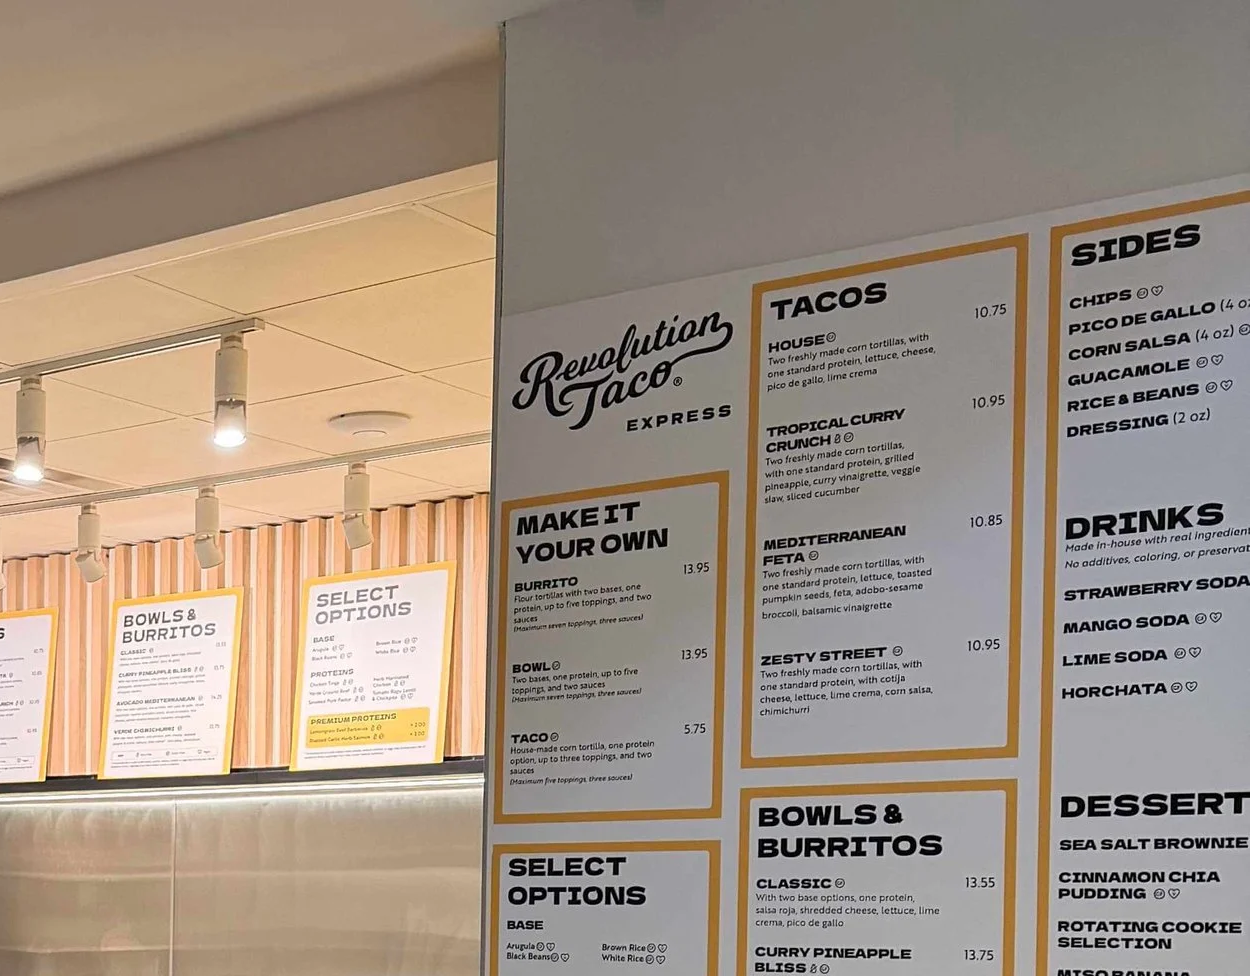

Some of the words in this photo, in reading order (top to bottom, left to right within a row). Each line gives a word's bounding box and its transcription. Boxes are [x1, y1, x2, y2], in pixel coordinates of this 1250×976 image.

[1071, 224, 1200, 266] SIDES
[770, 282, 887, 320] TACOS
[1069, 289, 1132, 309] CHIPS
[975, 303, 1007, 319] 10.75
[1069, 317, 1118, 335] PICO
[1121, 312, 1147, 327] DE
[1150, 302, 1215, 322] GALLO
[768, 334, 825, 353] HOUSE
[1068, 343, 1121, 360] CORN
[1125, 332, 1191, 352] SALSA
[1213, 324, 1234, 339] oz)
[512, 312, 733, 420] Revolution
[1068, 358, 1190, 386] GUACAMOLE
[972, 394, 1005, 409] 10.95
[1067, 395, 1115, 412] RICE
[1118, 394, 1129, 405] &
[1133, 384, 1199, 403] BEANS
[627, 405, 731, 432] EXPRESS
[766, 417, 849, 437] TROPICAL
[850, 408, 905, 426] CURRY
[1067, 414, 1169, 438] DRESSING
[1173, 412, 1185, 425] (2
[1190, 408, 1210, 422] oz)
[766, 434, 831, 453] CRUNCH
[517, 507, 599, 536] MAKE
[604, 501, 640, 524] IT
[970, 514, 1003, 528] 10.85
[1065, 503, 1224, 543] DRINKS
[516, 538, 595, 564] YOUR
[601, 528, 668, 554] OWN
[763, 525, 906, 551] MEDITERRANEAN
[1065, 542, 1094, 552] Made
[1096, 539, 1142, 550] in-house
[1145, 534, 1167, 545] with
[1170, 532, 1192, 542] real
[763, 552, 805, 566] FETA
[1065, 560, 1079, 569] No
[1082, 556, 1131, 567] additives,
[1134, 552, 1180, 562] coloring,
[1183, 550, 1195, 558] or
[684, 562, 709, 575] 13.95
[514, 576, 578, 592] BURRITO
[1064, 580, 1193, 601] STRAWBERRY
[1196, 575, 1250, 590] SODA
[317, 585, 399, 607] SELECT
[124, 609, 183, 628] BOWLS
[187, 608, 196, 621] &
[315, 602, 412, 625] OPTIONS
[1063, 618, 1132, 634] MANGO
[1136, 614, 1190, 628] SODA
[122, 623, 216, 644] BURRITOS
[313, 635, 335, 643] BASE
[968, 638, 1000, 651] 10.95
[682, 648, 707, 660] 13.95
[761, 652, 816, 666] ZESTY
[820, 647, 887, 661] STREET
[1062, 653, 1111, 667] LIME
[1114, 649, 1168, 663] SODA
[310, 668, 354, 678] PROTEINS
[512, 662, 551, 674] BOWL
[1062, 683, 1167, 699] HORCHATA
[310, 717, 350, 725] PREMIUM
[351, 713, 397, 722] PROTEINS
[684, 723, 706, 734] 5.75
[511, 733, 549, 744] TACO
[1061, 792, 1250, 818] DESSERT
[759, 804, 877, 827] BOWLS
[883, 804, 903, 824] &
[758, 835, 942, 858] BURRITOS
[1060, 839, 1097, 851] SEA
[1101, 839, 1151, 850] SALT
[1154, 837, 1249, 849] BROWNIE
[508, 857, 626, 877] SELECT
[756, 878, 832, 889] CLASSIC
[966, 877, 995, 888] 13.55
[1059, 871, 1165, 883] CINNAMON
[1168, 871, 1220, 883] CHIA
[508, 886, 646, 905] OPTIONS
[1058, 888, 1146, 899] PUDDING
[507, 920, 543, 930] BASE
[1058, 921, 1158, 933] ROTATING
[1162, 921, 1242, 933] COOKIE
[506, 942, 535, 952] Arugula
[602, 943, 627, 951] Brown
[629, 944, 646, 952] Rice
[1058, 937, 1172, 949] SELECTION
[506, 952, 526, 960] Black
[528, 953, 550, 962] Beans
[601, 953, 625, 962] White
[627, 954, 644, 962] Rice
[755, 947, 810, 957] CURRY
[813, 948, 912, 959] PINEAPPLE
[964, 949, 994, 961] 13.75
[755, 962, 806, 973] BLISS
